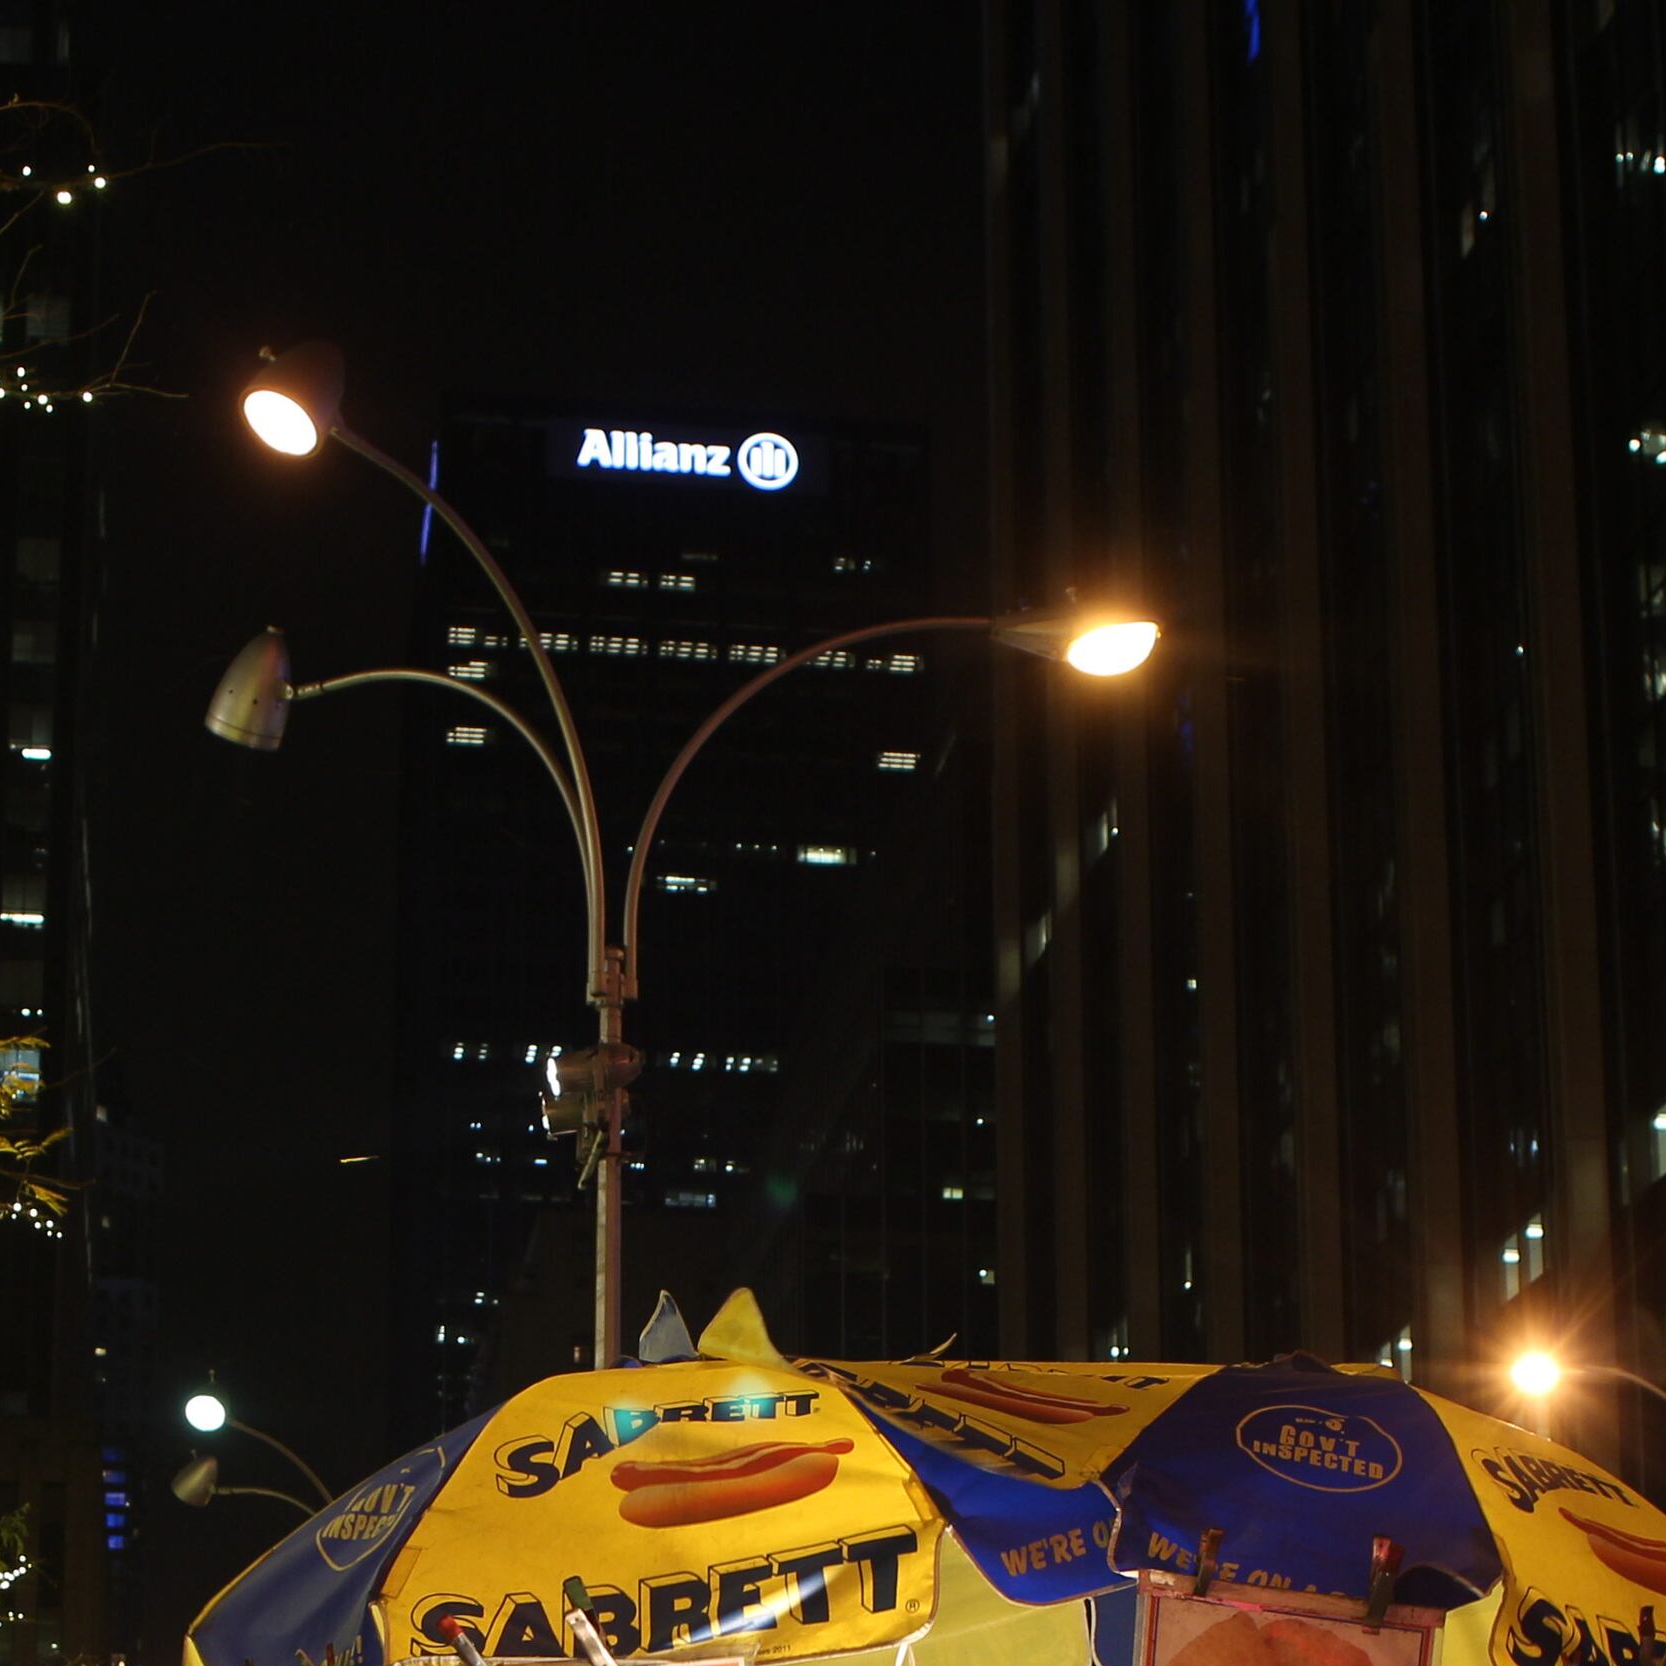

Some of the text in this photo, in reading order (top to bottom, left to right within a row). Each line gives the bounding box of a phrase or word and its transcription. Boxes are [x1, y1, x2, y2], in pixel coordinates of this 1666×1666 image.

[577, 428, 731, 476] Allianz
[496, 1391, 820, 1499] SABRETT
[1252, 1440, 1383, 1480] INSPECTED
[1279, 1424, 1361, 1457] GOV'T
[1000, 1527, 1088, 1578] WE'RE
[410, 1523, 918, 1660] SABRETT
